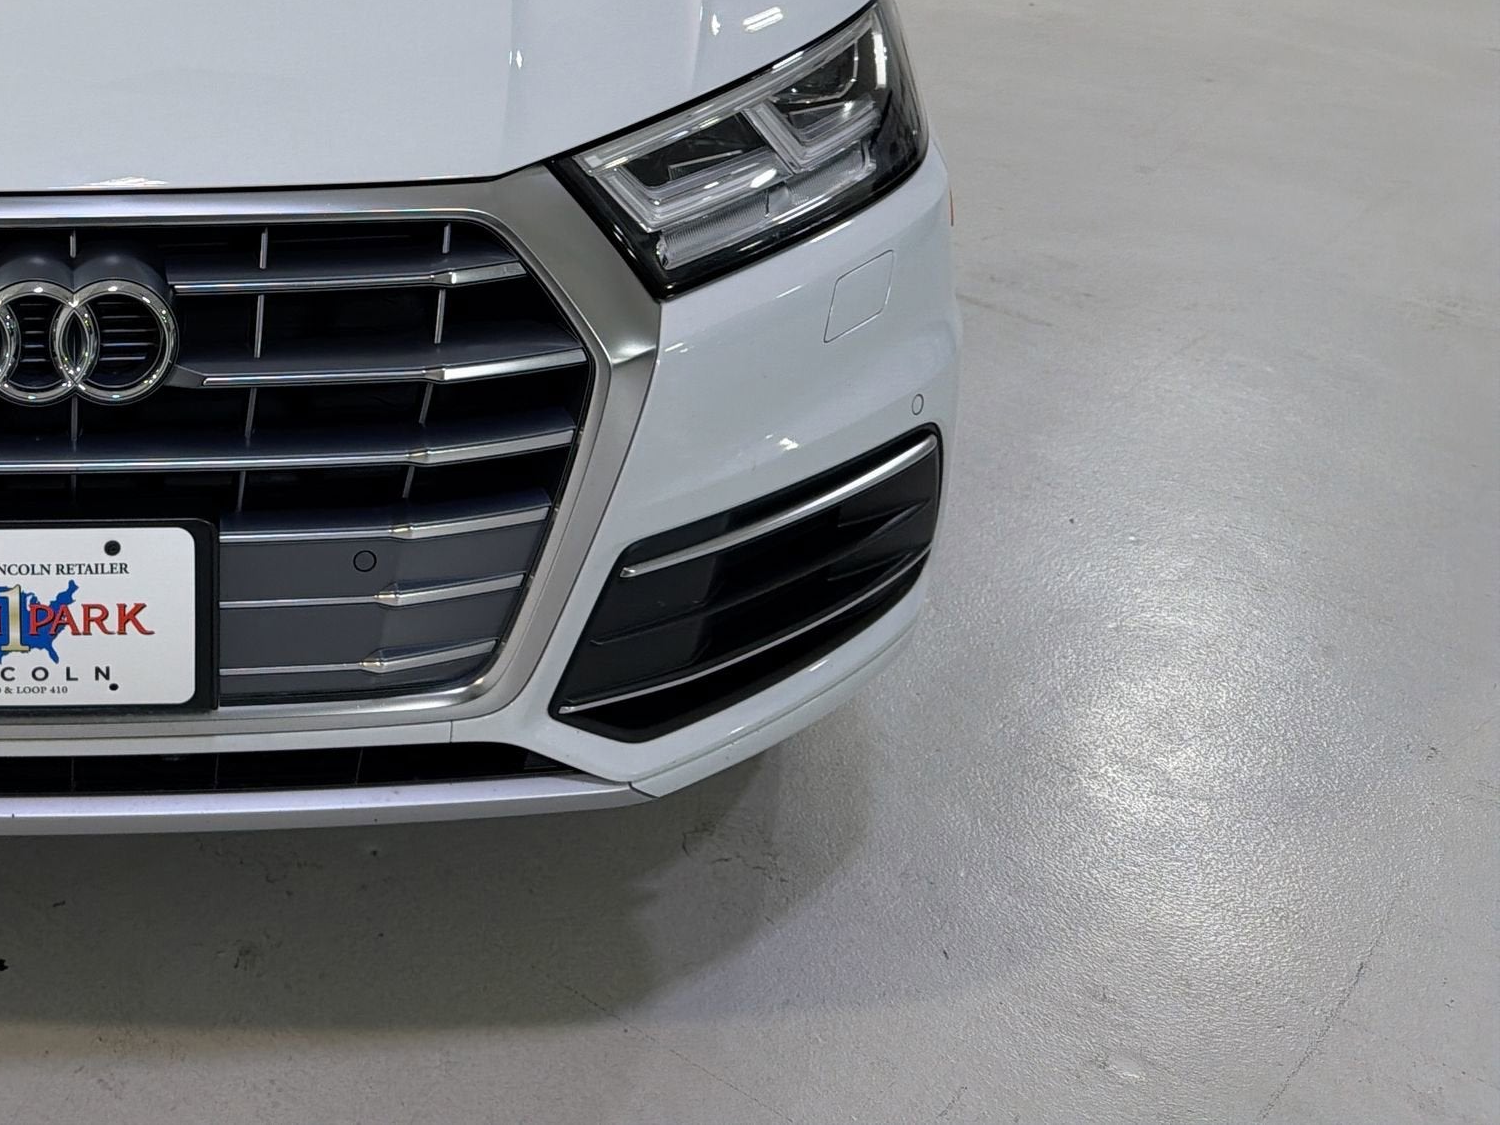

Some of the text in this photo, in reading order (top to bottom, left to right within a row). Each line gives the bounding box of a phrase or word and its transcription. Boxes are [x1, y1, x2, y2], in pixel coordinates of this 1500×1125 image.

[55, 562, 130, 575] RETAILER
[29, 602, 156, 636] PARK
[4, 686, 13, 695] &
[16, 686, 48, 695] LOOP
[49, 685, 68, 695] 410
